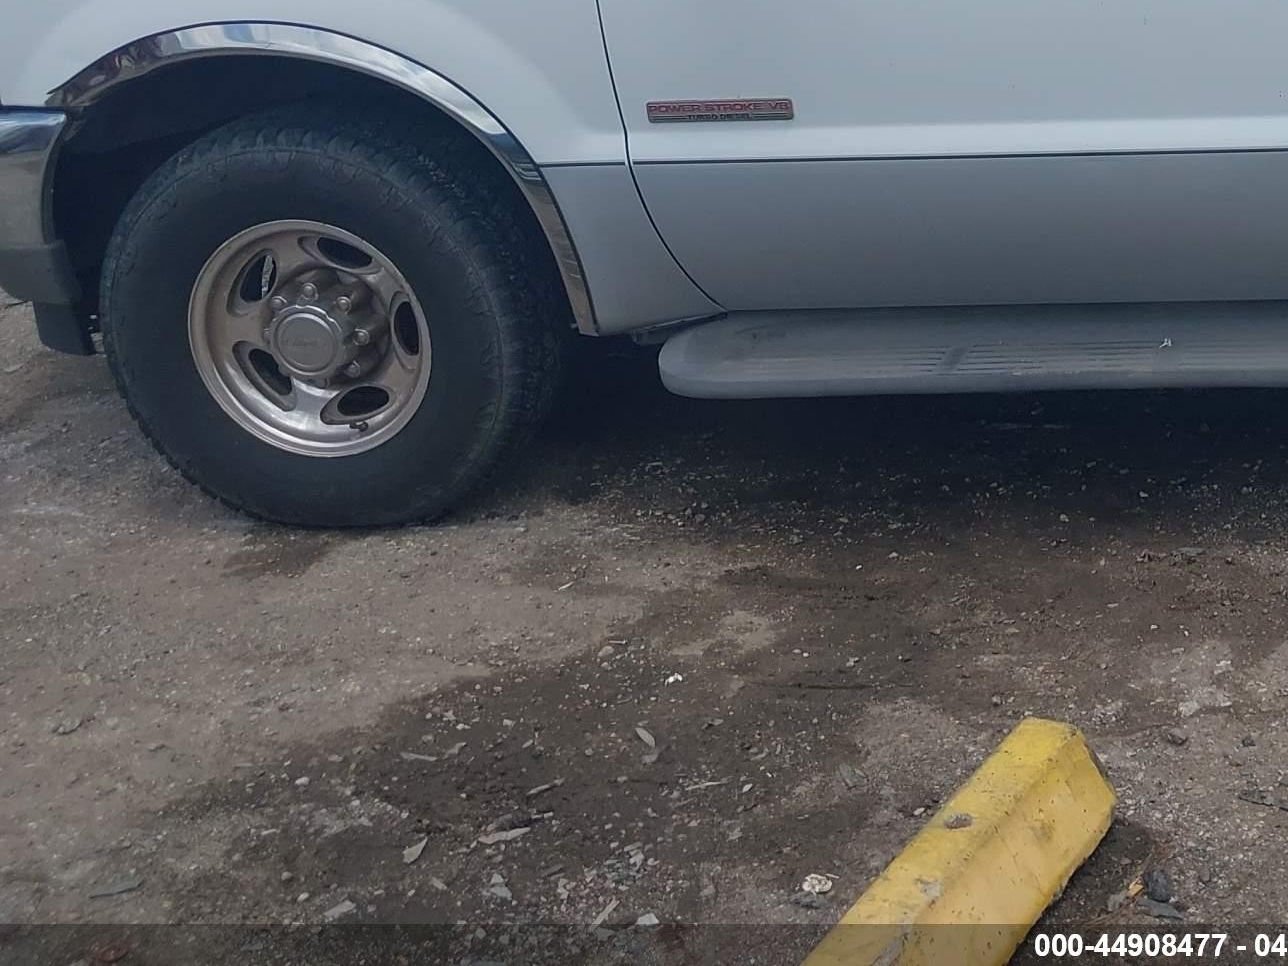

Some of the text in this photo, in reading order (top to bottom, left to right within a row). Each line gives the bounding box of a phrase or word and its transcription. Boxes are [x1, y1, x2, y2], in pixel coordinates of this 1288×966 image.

[648, 101, 789, 113] POWER STROKE V8
